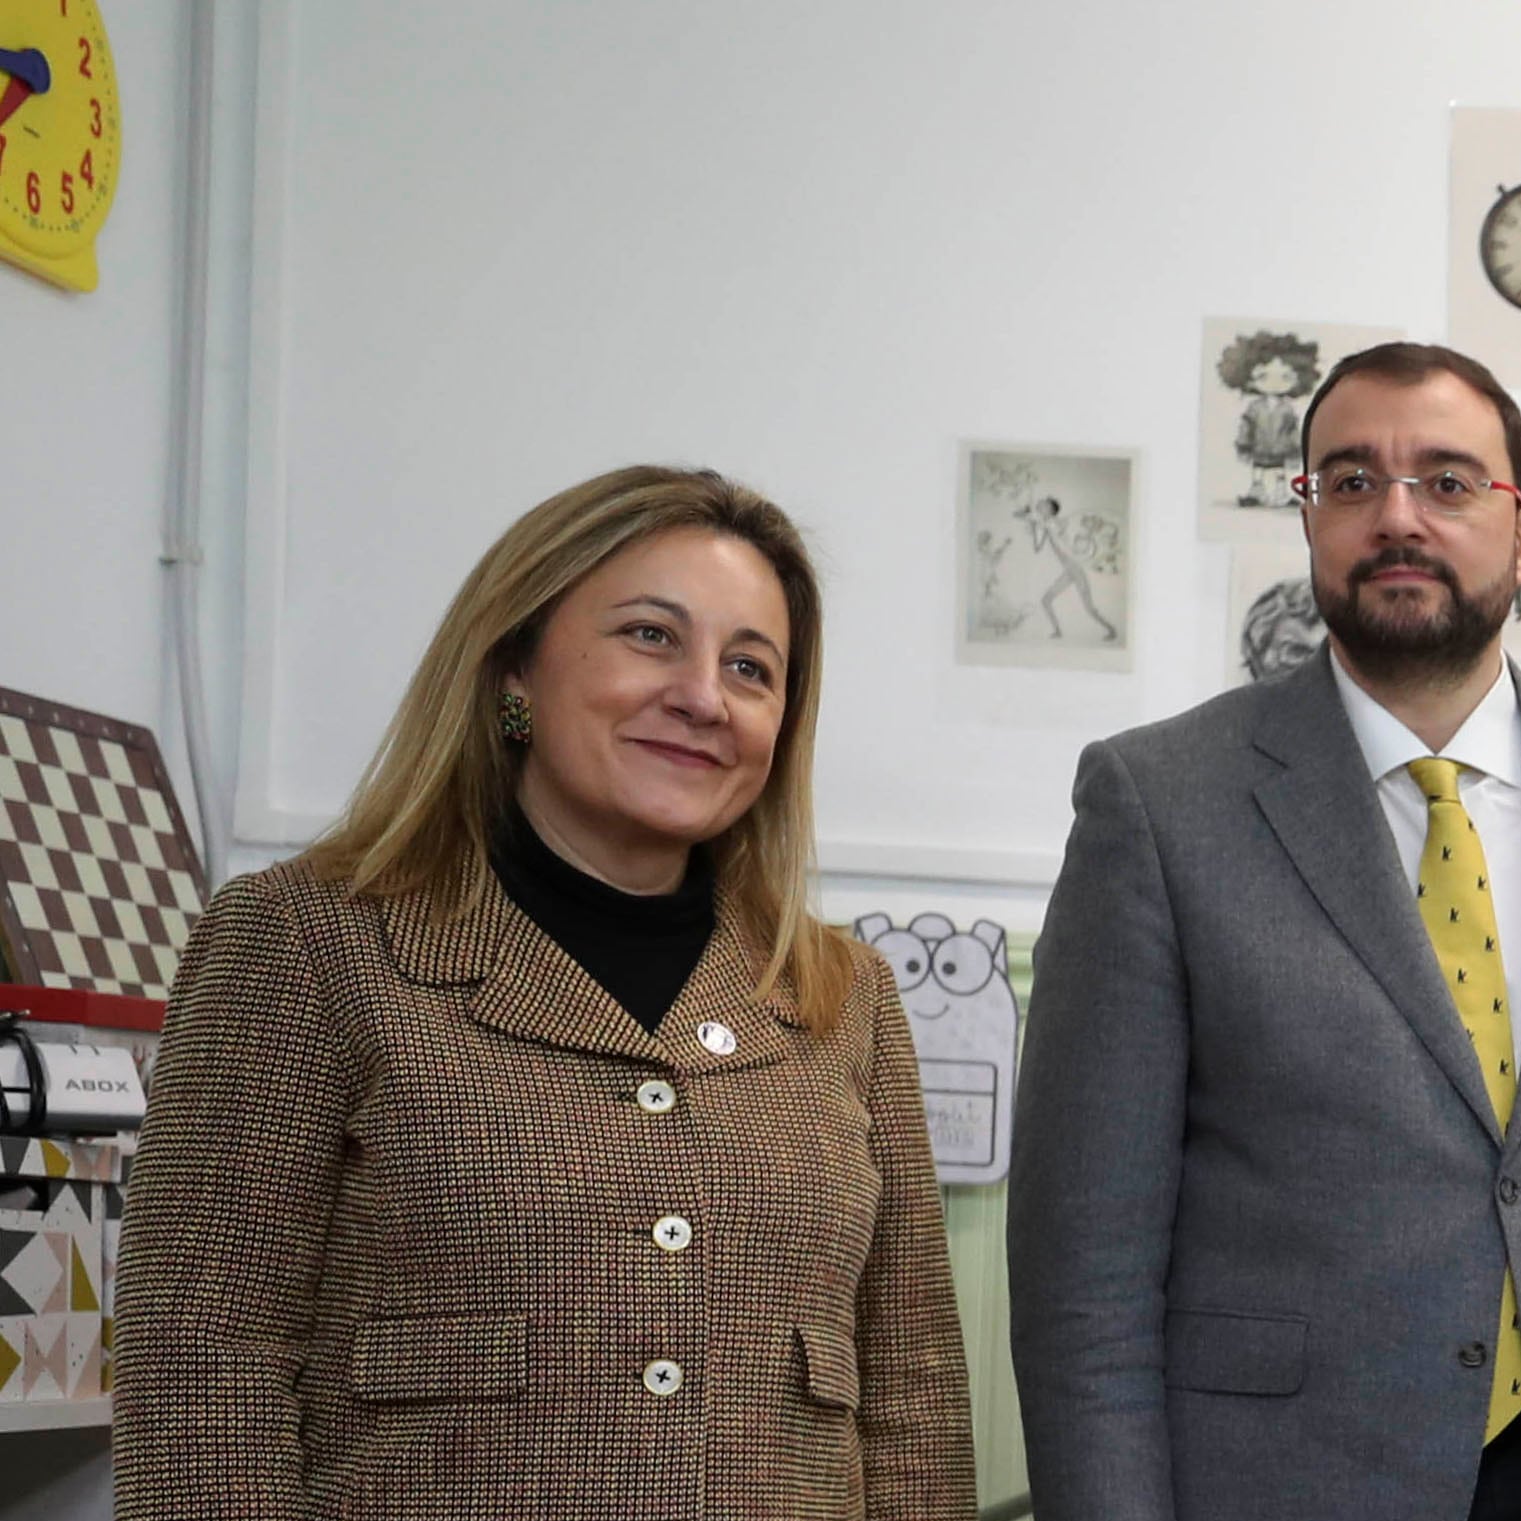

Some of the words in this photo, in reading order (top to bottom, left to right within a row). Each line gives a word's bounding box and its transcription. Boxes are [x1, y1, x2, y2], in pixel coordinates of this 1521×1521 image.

[79, 37, 92, 79] 2
[90, 98, 101, 138] 3
[80, 150, 94, 190] 4
[27, 171, 41, 215] 6
[61, 170, 74, 214] 5
[65, 1079, 130, 1093] ABOX
